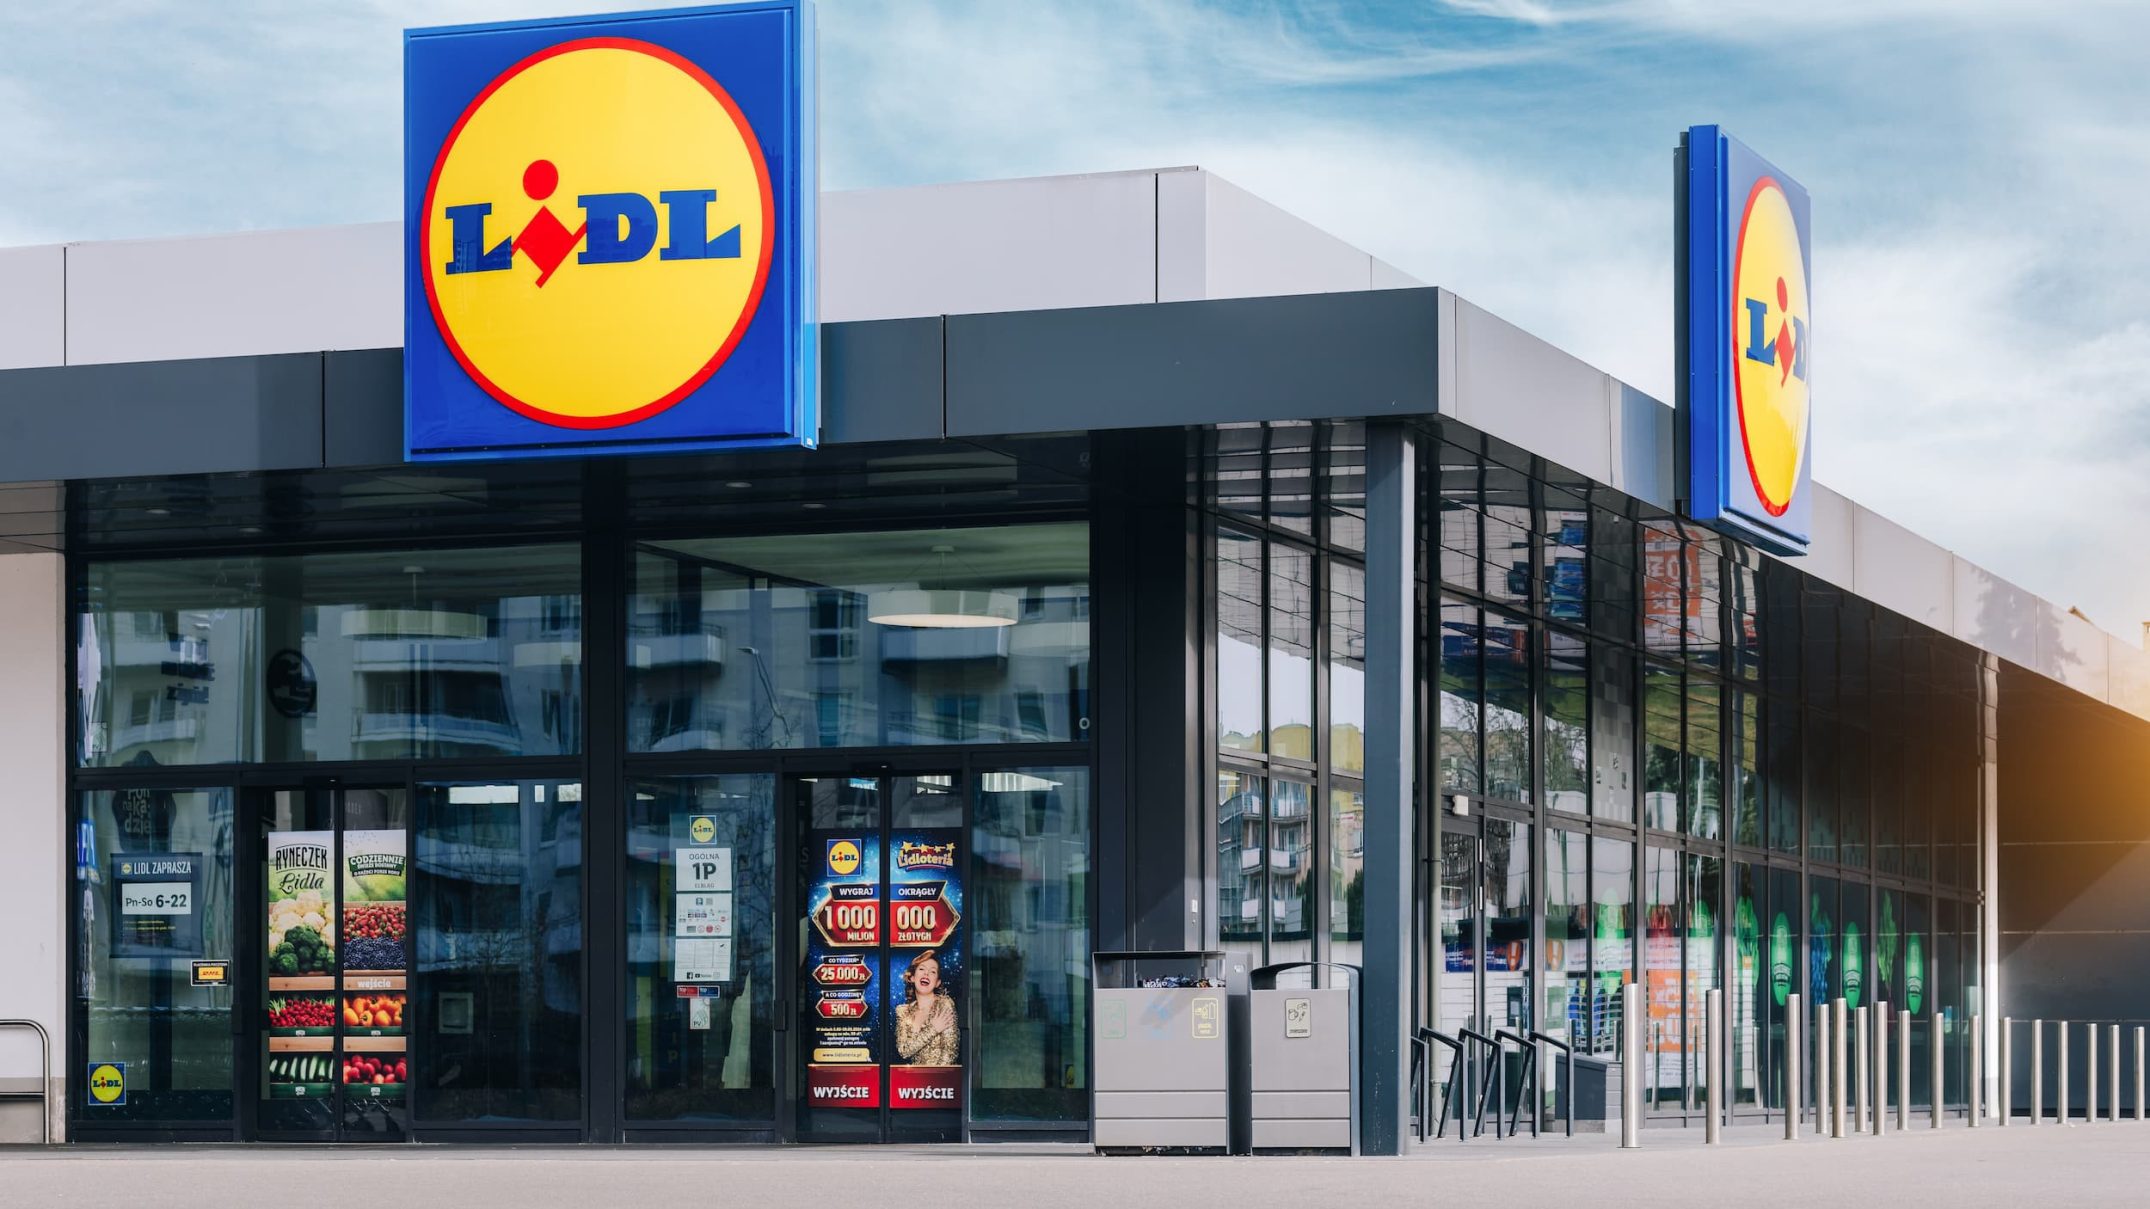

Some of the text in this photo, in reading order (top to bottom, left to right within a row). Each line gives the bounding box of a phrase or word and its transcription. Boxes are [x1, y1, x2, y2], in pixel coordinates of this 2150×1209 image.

[1746, 276, 1807, 388] LID
[276, 847, 327, 870] RYNECZEK
[350, 855, 404, 865] CODZIENNIE
[831, 851, 857, 862] LIDL
[152, 861, 192, 874] ZAPRASZA
[692, 862, 717, 880] 1P
[279, 872, 324, 894] Lidla
[839, 887, 936, 897] WYGRAJ OKRĄGŁY
[126, 894, 187, 908] Pn-So 6-22
[837, 905, 876, 930] 000
[896, 905, 936, 930] 000
[847, 932, 874, 941] MILION
[831, 1004, 849, 1016] 500
[93, 1077, 122, 1089] LIDL
[813, 1085, 954, 1099] WYJŚCIE WYJŚCIE
